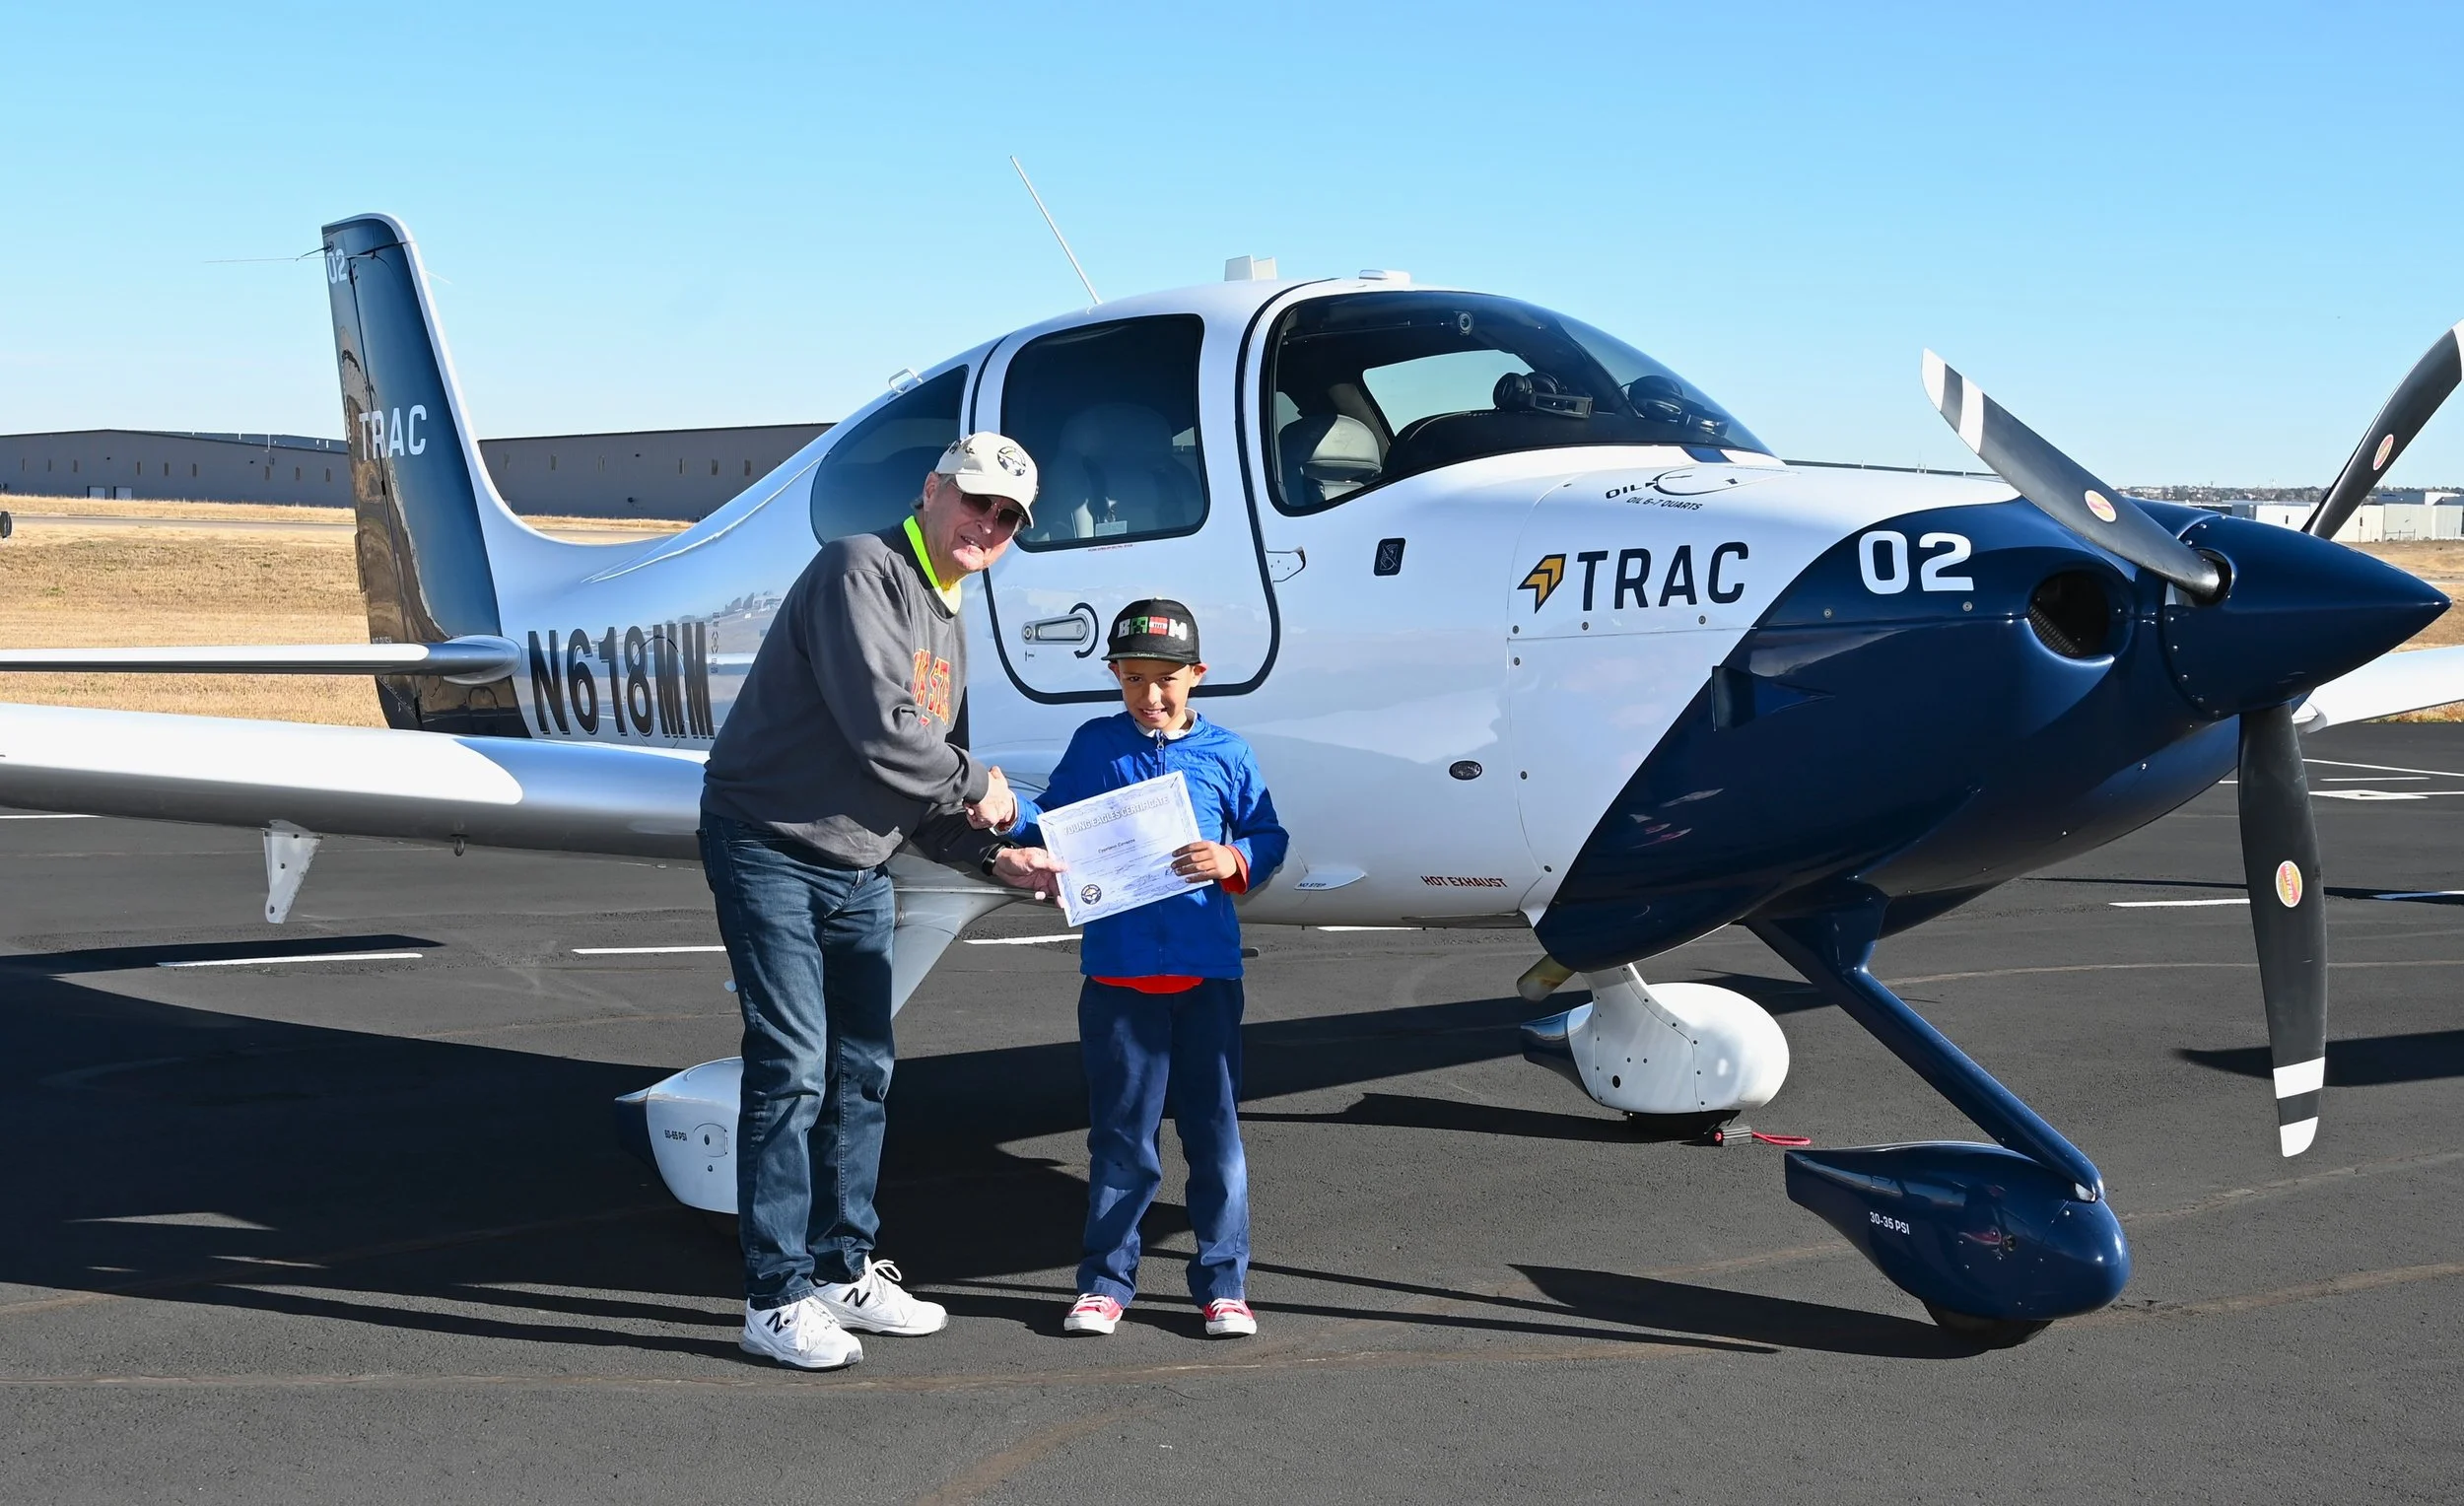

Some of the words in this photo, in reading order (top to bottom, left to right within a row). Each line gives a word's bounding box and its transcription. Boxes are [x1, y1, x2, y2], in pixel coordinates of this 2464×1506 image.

[326, 247, 347, 284] 02
[359, 404, 427, 461] TRAC
[1606, 483, 1642, 499] OIL
[1626, 496, 1642, 505] OIL
[1661, 500, 1703, 511] QUARTS
[1576, 541, 1749, 611] TRAC
[1858, 530, 1974, 594] 02
[1092, 810, 1122, 828] EAGLES
[1121, 796, 1171, 817] CERTIFICATE
[1420, 875, 1449, 886] HOT
[1446, 876, 1508, 887] EXHAUST
[1869, 1210, 1894, 1230] 30-35
[1894, 1219, 1910, 1235] PSI
